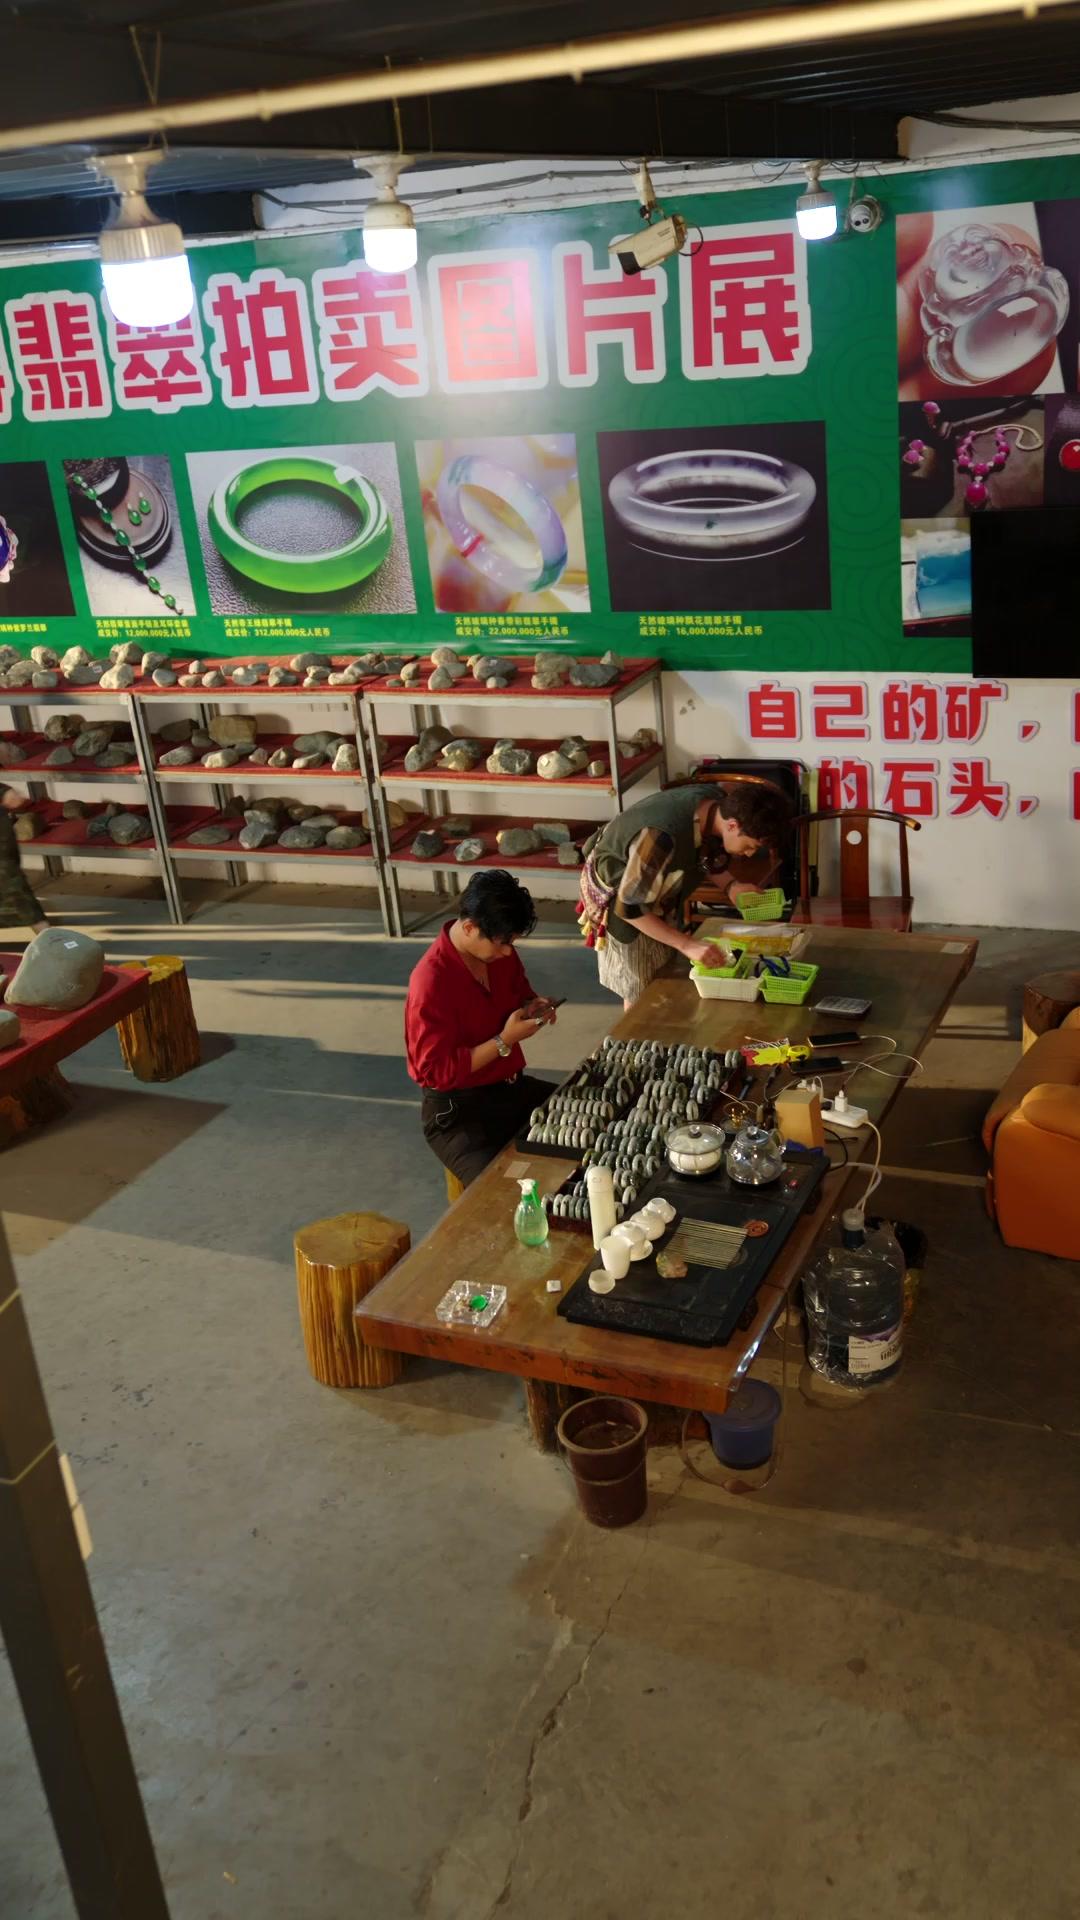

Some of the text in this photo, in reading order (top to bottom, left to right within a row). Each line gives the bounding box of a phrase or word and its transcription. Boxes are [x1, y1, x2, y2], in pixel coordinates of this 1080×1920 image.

[0, 233, 799, 412] 翡翠拍卖图片展
[748, 683, 1080, 743] 自己的矿，
